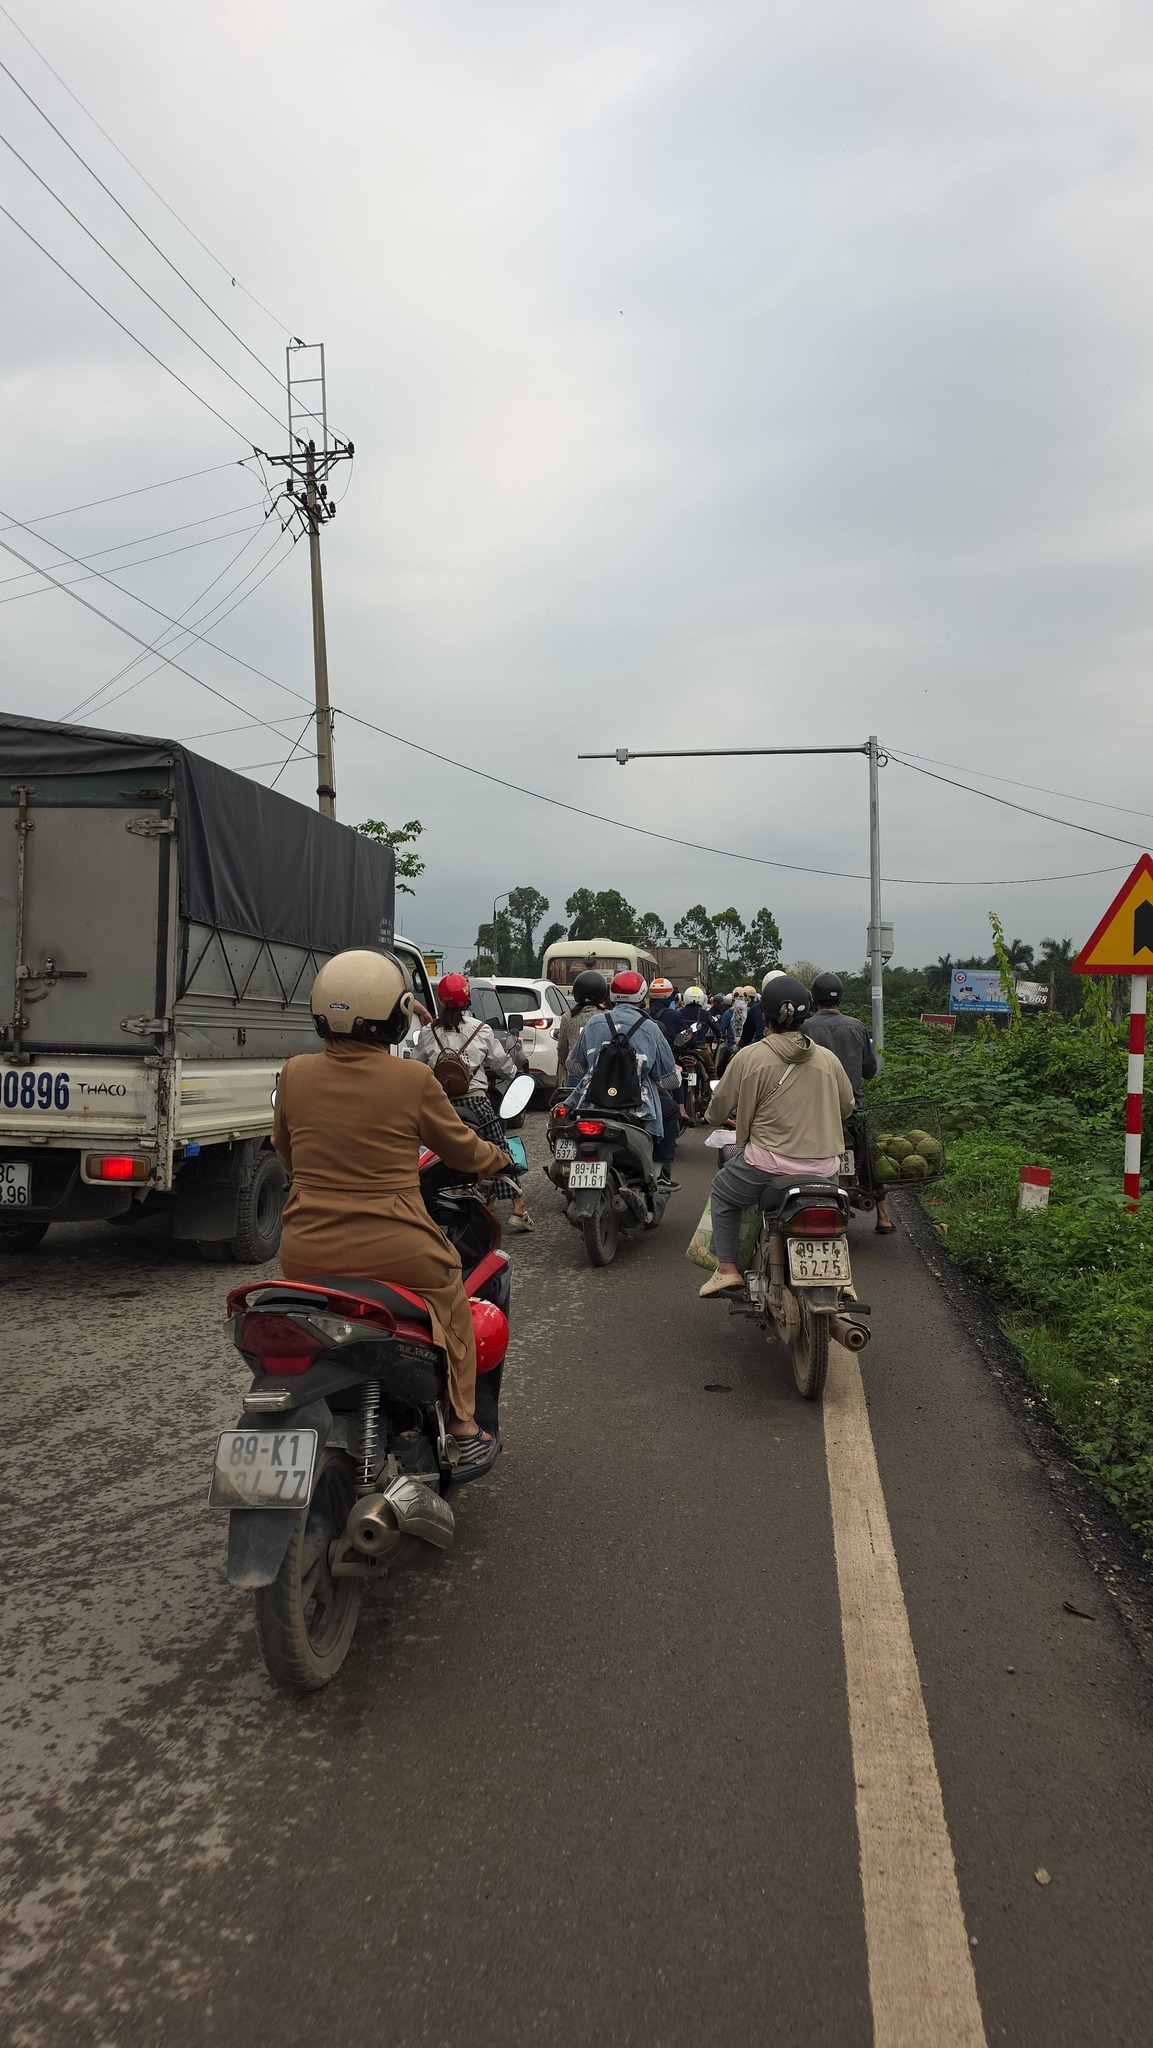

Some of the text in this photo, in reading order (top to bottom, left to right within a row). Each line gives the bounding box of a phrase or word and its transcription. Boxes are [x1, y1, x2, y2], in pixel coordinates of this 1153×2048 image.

[0, 1070, 70, 1110] 0896
[77, 1082, 126, 1097] THACO
[575, 1163, 601, 1175] 89-AF
[570, 1175, 605, 1187] 011.61
[0, 1185, 26, 1204] .96
[229, 1435, 300, 1466] 89-K1
